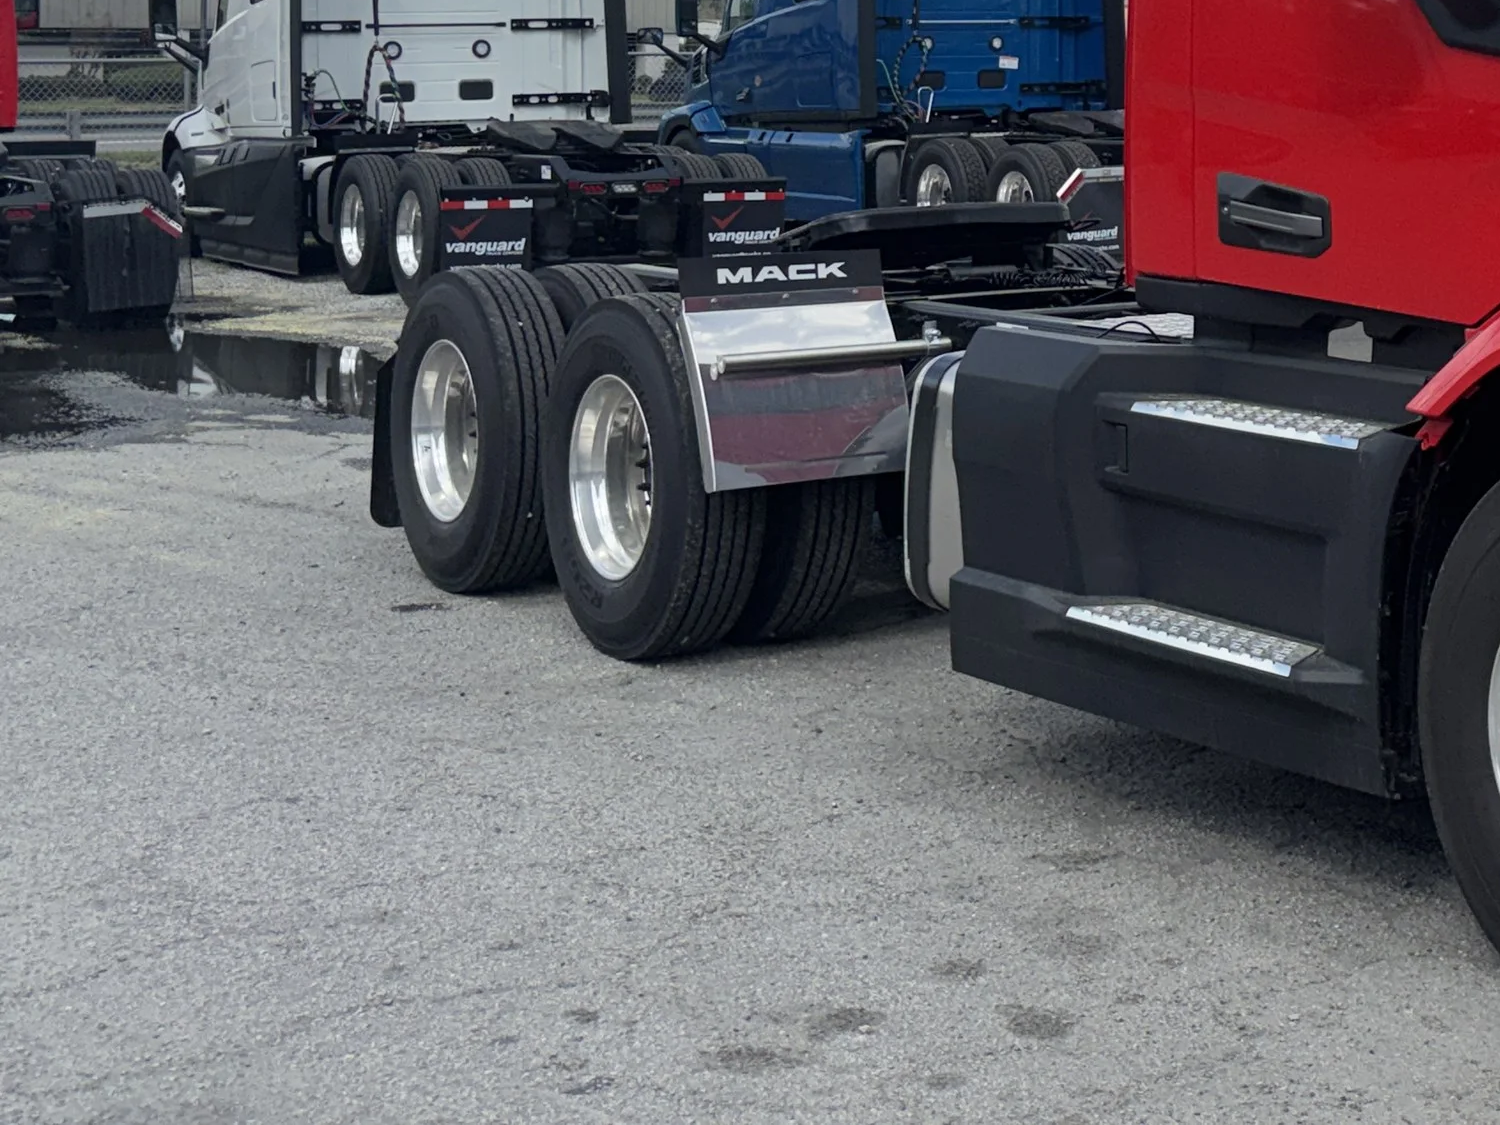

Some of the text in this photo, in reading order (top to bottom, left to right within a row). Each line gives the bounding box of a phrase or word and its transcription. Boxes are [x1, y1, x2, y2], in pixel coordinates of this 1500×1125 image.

[708, 227, 780, 244] vanguard
[1066, 226, 1118, 242] vanguard
[445, 237, 526, 255] vanguard
[716, 261, 848, 284] MACK
